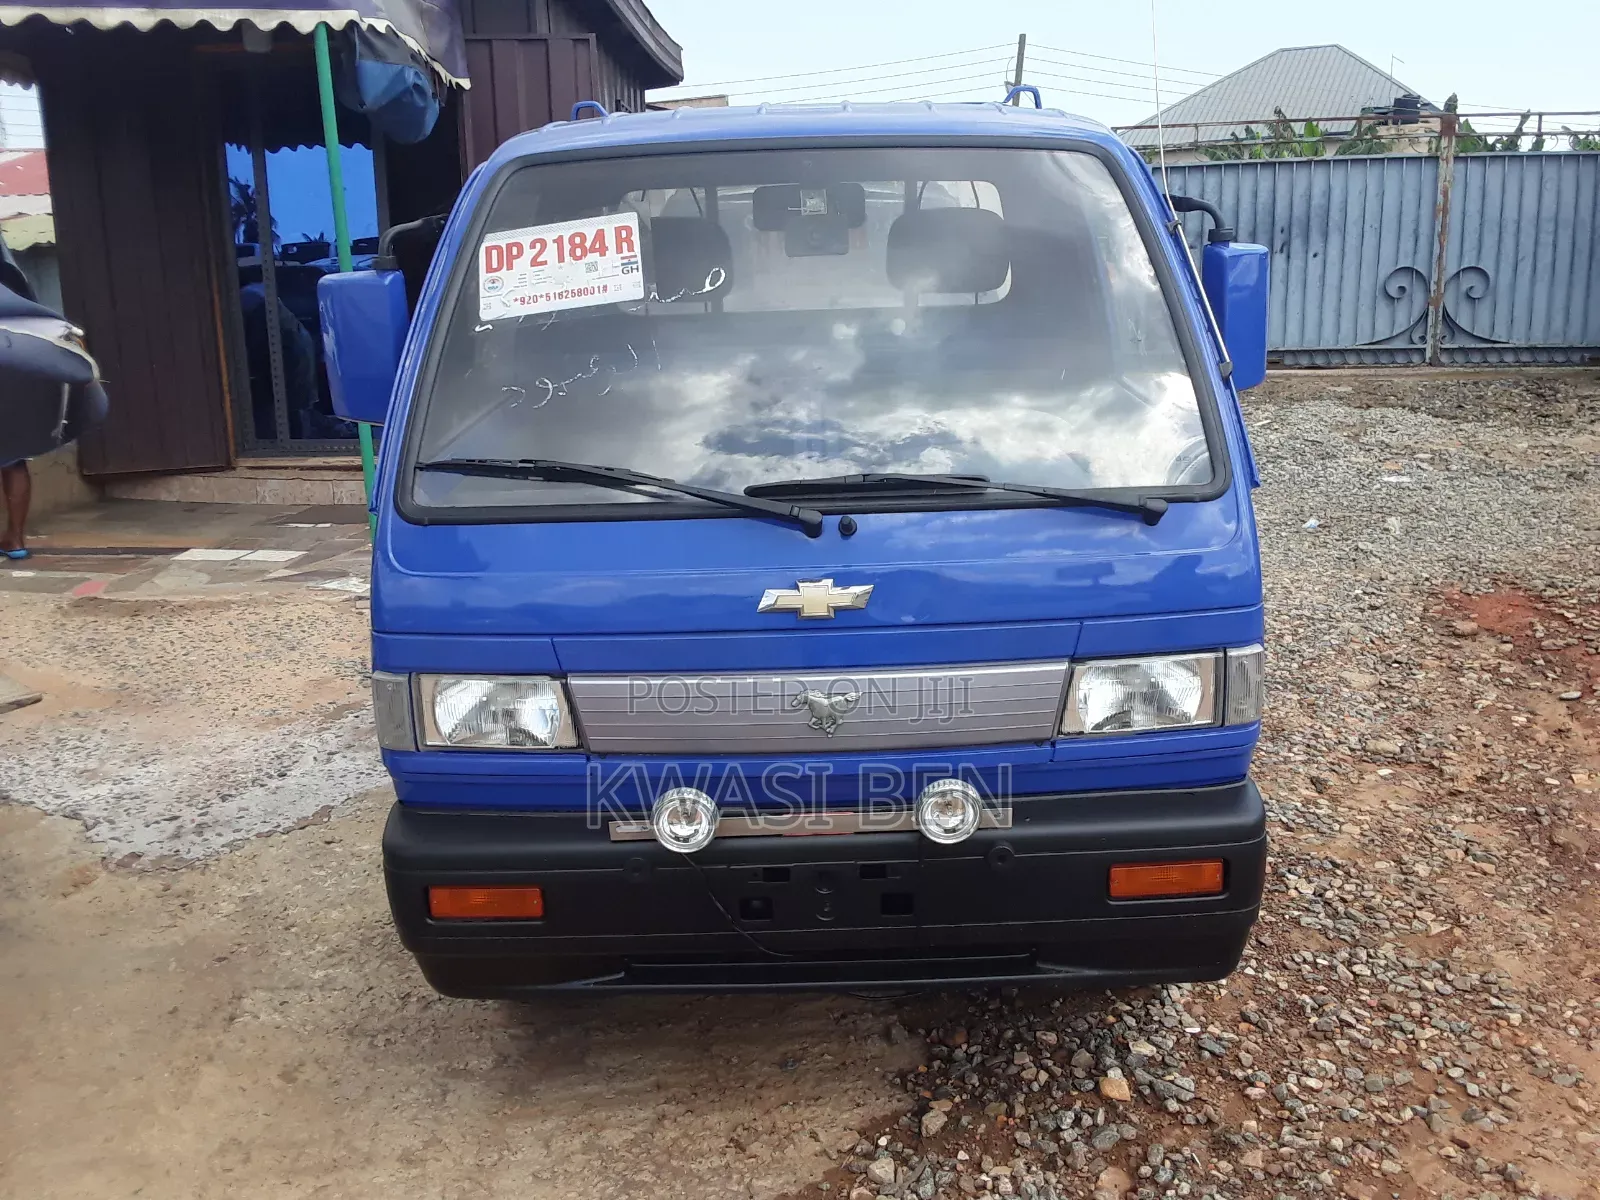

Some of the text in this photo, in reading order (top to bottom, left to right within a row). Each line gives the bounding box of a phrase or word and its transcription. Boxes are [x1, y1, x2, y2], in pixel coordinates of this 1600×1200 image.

[485, 225, 635, 274] DP 2184 R
[621, 265, 640, 275] GH
